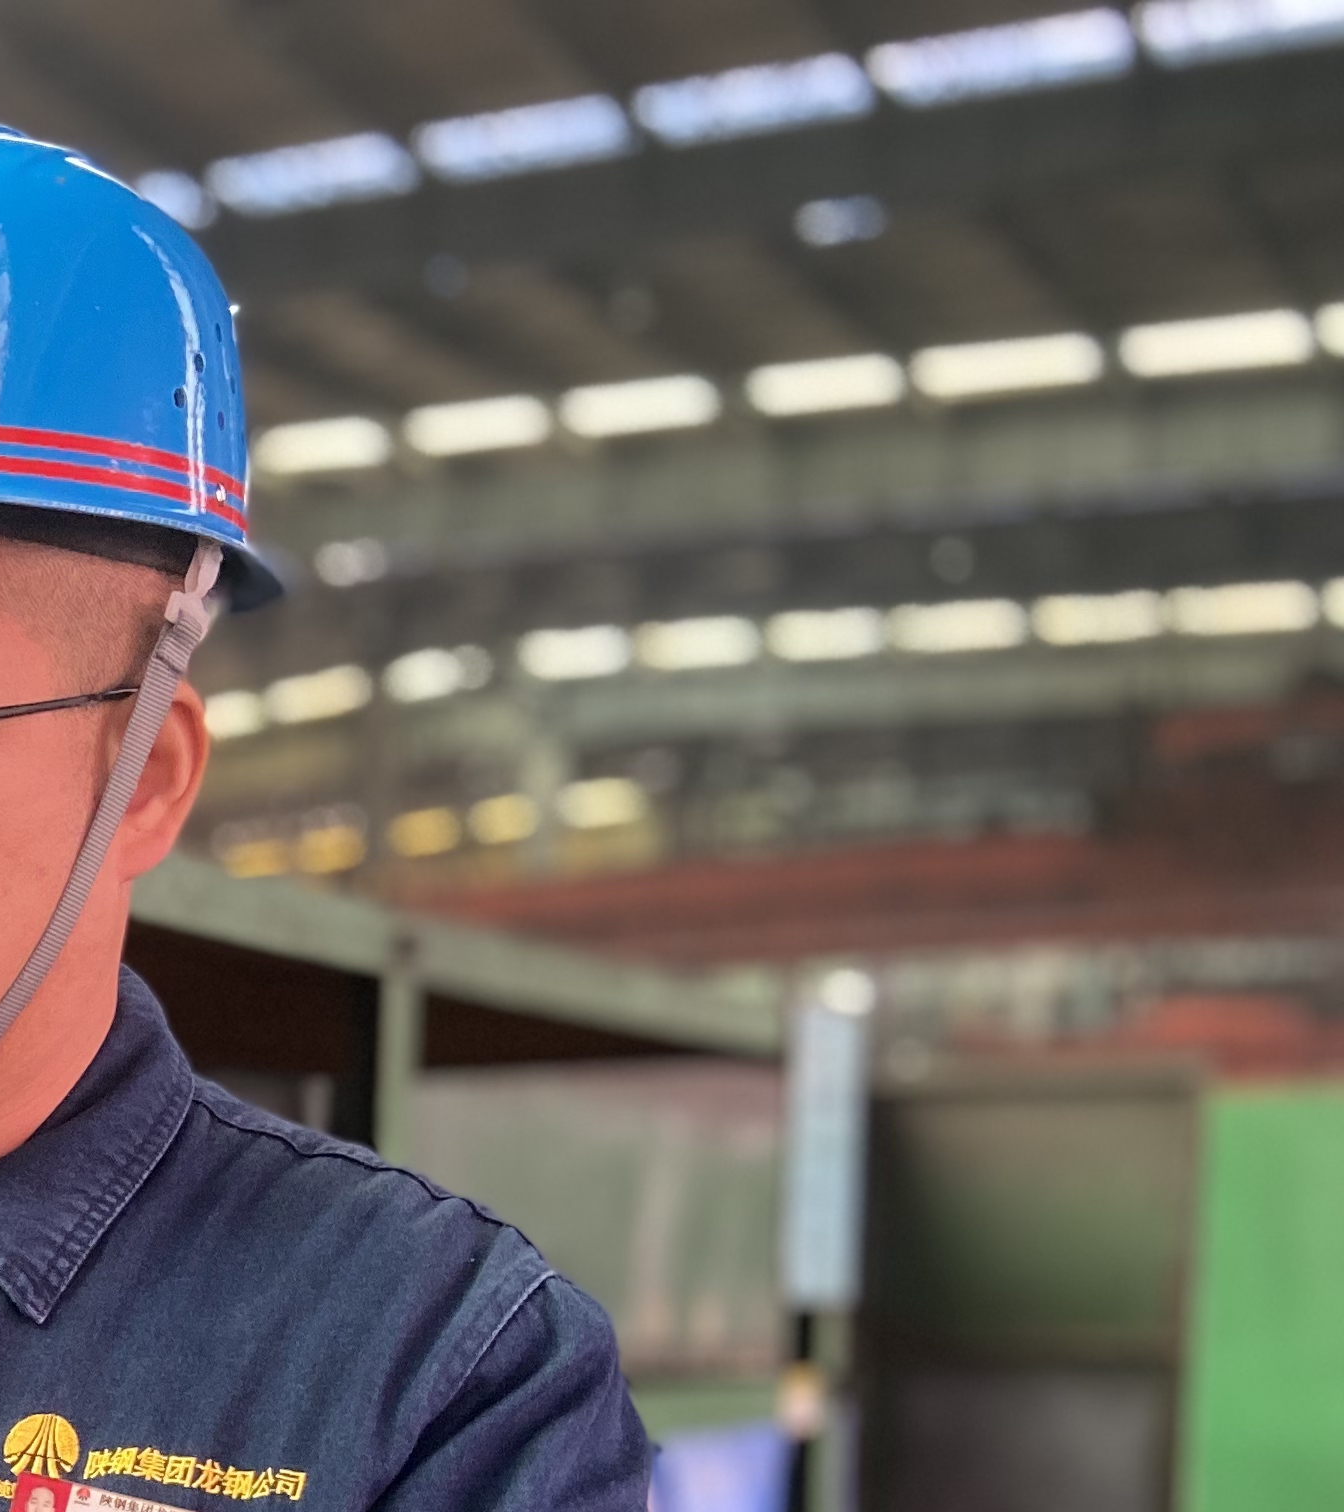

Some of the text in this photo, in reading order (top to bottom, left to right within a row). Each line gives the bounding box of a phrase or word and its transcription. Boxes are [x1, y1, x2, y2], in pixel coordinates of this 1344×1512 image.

[83, 1446, 308, 1501] 陕钢集团龙钢公司
